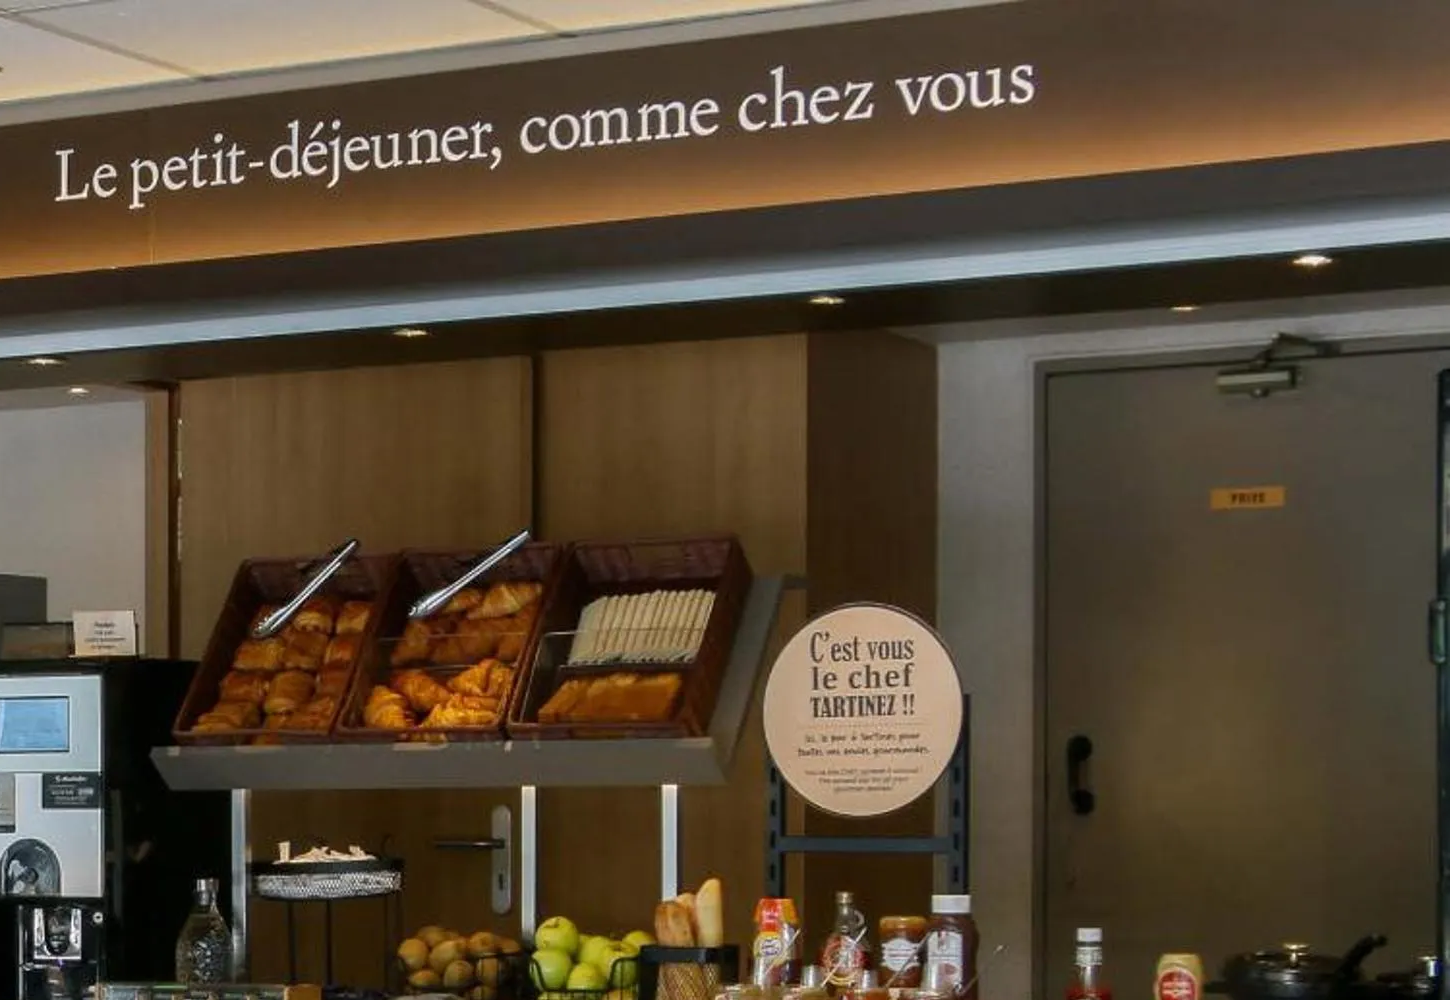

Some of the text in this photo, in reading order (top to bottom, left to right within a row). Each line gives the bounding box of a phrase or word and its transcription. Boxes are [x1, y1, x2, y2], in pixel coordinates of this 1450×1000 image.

[54, 63, 1036, 211] Le petit-déjeuner, comme chez vous
[810, 631, 915, 664] C'est vous
[811, 662, 916, 691] le chef
[810, 694, 897, 719] TARTINEZ
